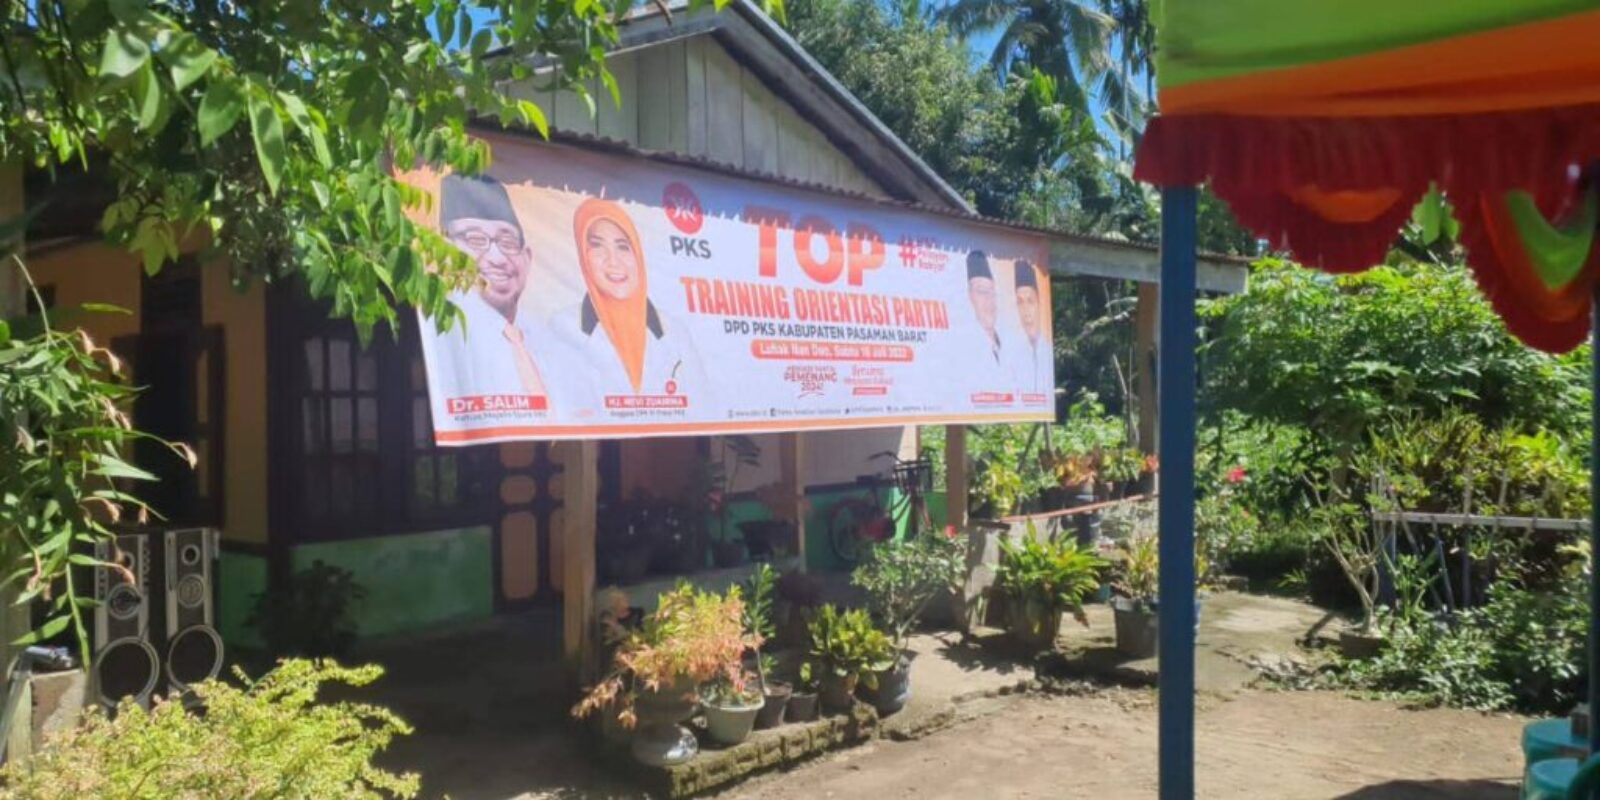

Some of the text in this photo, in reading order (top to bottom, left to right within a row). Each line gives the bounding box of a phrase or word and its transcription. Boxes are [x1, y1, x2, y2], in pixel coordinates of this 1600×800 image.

[670, 235, 711, 259] PKS
[743, 206, 885, 286] TOP
[680, 276, 949, 329] TRAINING ORIENTASI PARTAI
[723, 319, 928, 343] DPD PKS KABUPATEN PASAMAN BARAT
[784, 372, 838, 382] PEMENANG
[453, 396, 529, 412] Dr. SALIM
